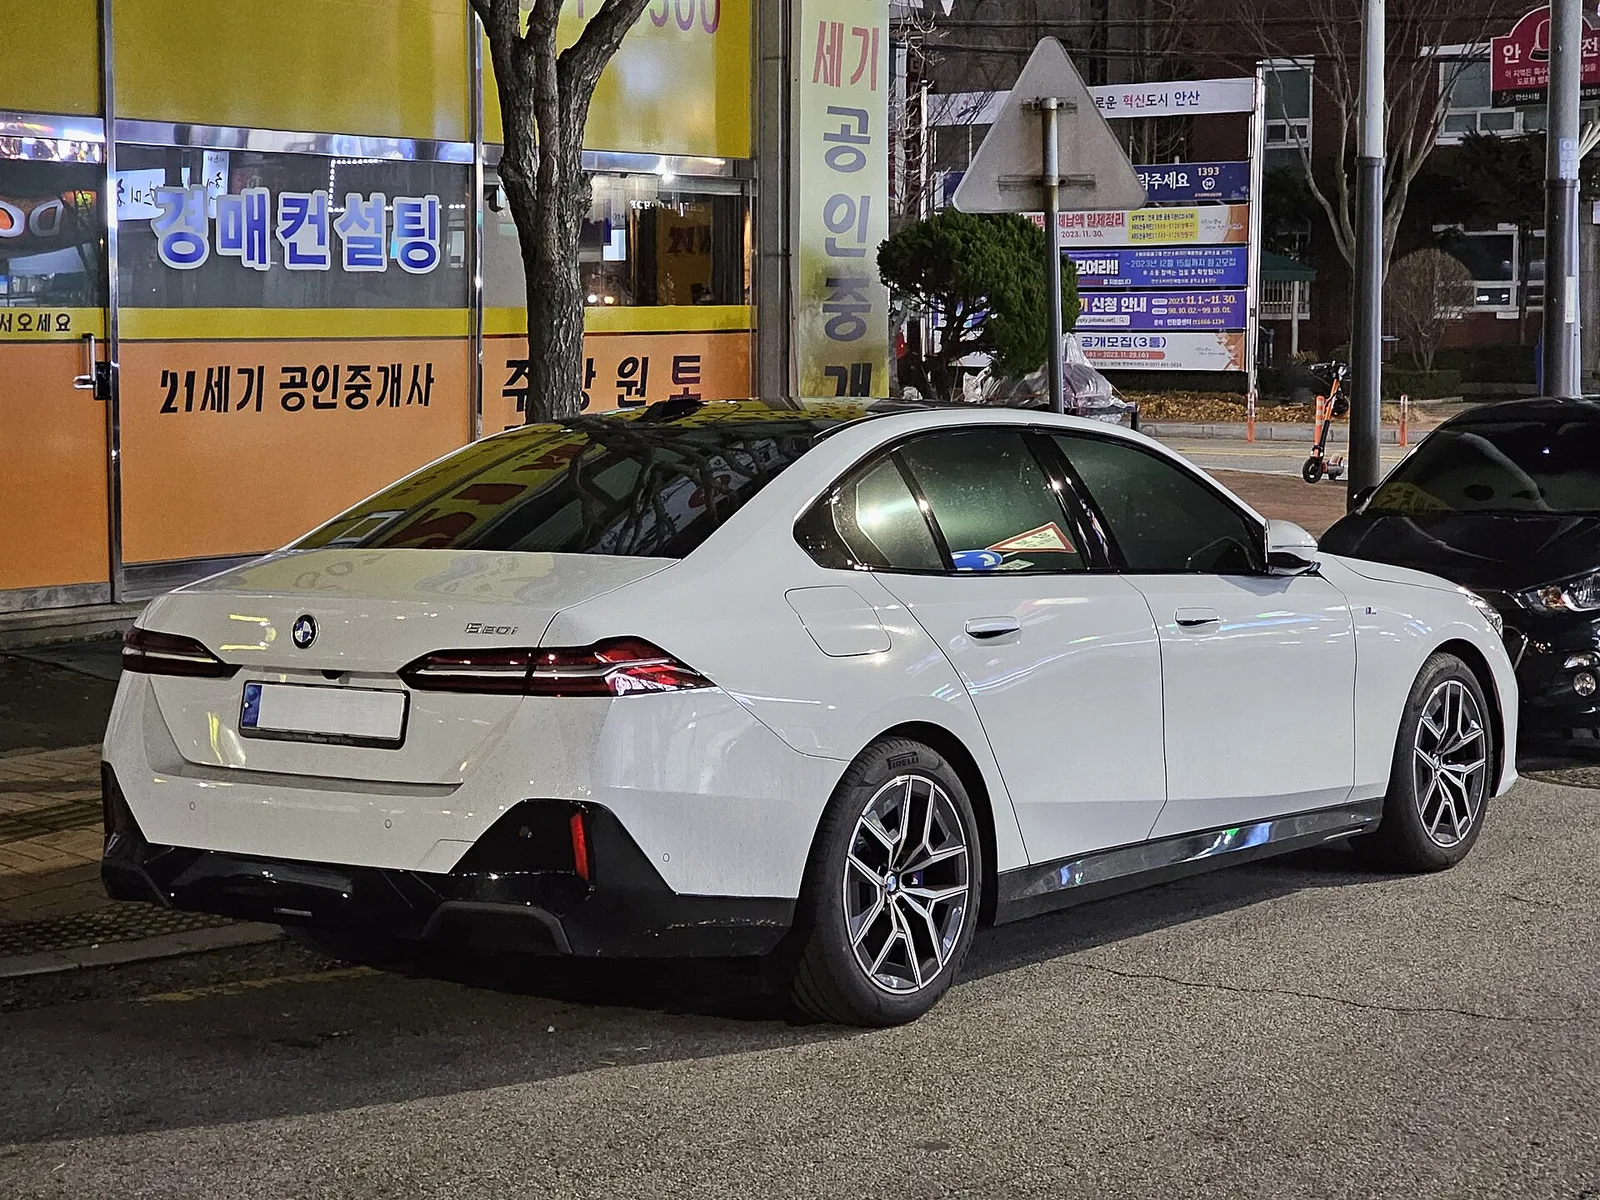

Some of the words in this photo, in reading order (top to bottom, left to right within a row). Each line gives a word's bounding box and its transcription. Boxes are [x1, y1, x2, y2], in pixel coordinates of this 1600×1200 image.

[812, 21, 879, 91] 세기
[1503, 43, 1521, 64] 안
[1122, 93, 1168, 109] 혁신도시
[1174, 90, 1200, 106] 안산
[1198, 167, 1219, 177] 1393
[150, 184, 440, 274] 경매컨설팅
[1087, 212, 1125, 228] 일제정리
[1091, 298, 1118, 313] 신청
[1121, 297, 1147, 313] 안내
[0, 313, 71, 333] 서오세요
[160, 366, 263, 414] 21세기
[279, 363, 434, 412] 공인중개사
[465, 622, 519, 635] 520i
[886, 752, 919, 770] PIRELLI
